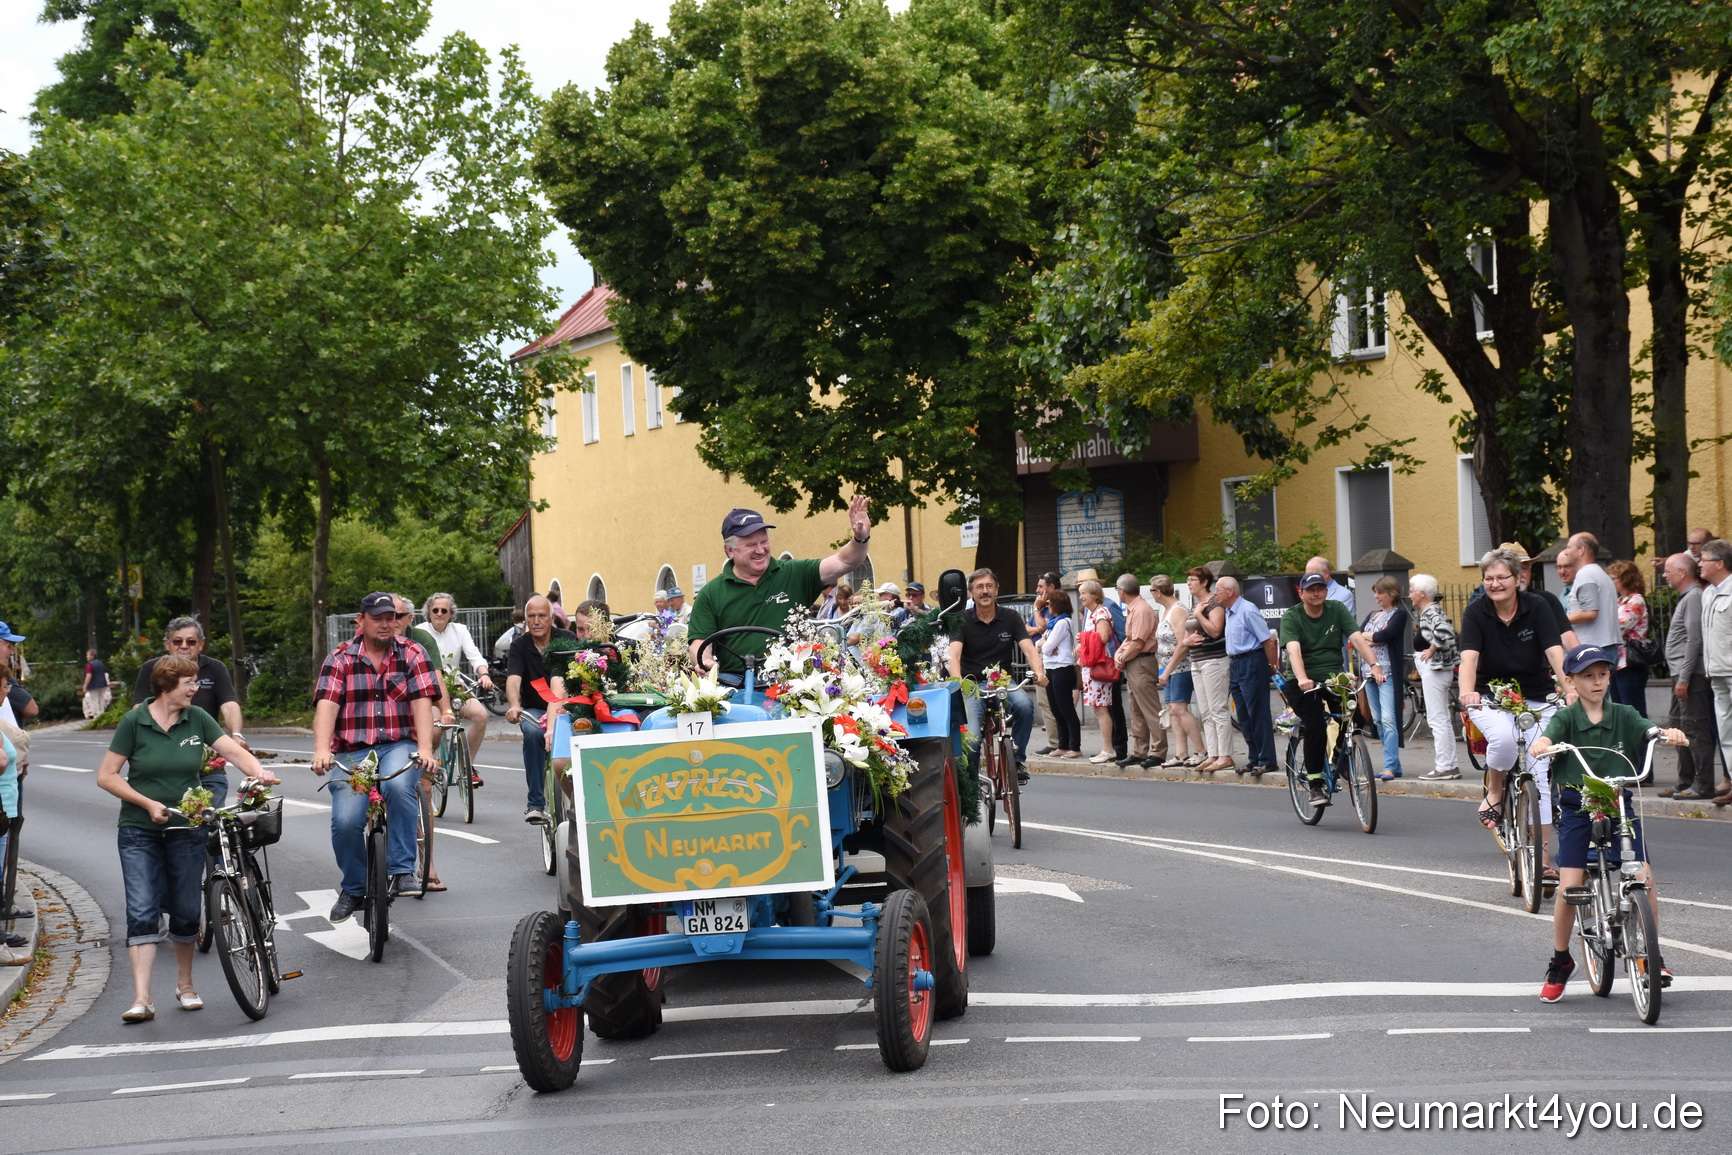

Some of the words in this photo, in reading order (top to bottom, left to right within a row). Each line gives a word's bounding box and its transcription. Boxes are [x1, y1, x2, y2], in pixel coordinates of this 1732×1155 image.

[687, 721, 704, 735] 17
[636, 768, 764, 809] EXPRESS
[694, 900, 716, 916] NM
[688, 917, 709, 933] GA
[714, 915, 744, 931] 824
